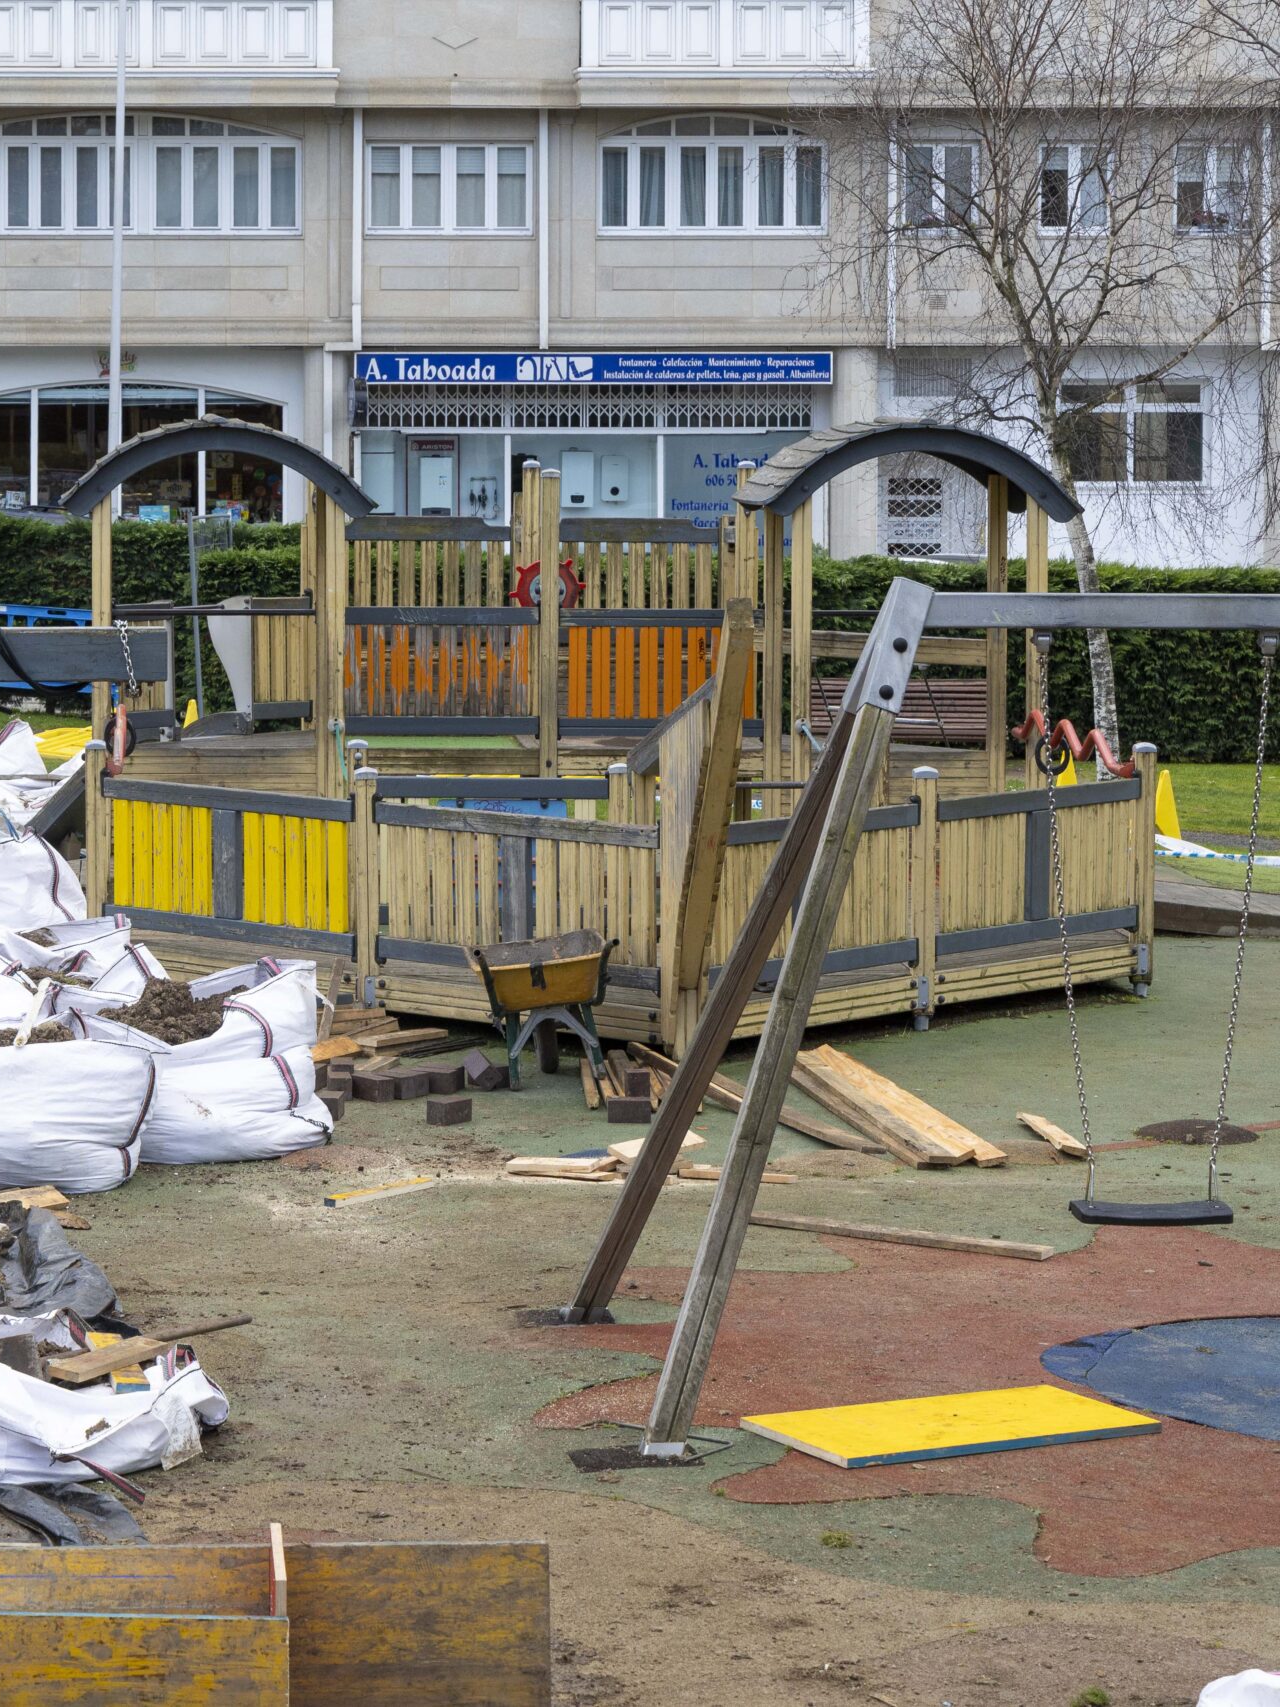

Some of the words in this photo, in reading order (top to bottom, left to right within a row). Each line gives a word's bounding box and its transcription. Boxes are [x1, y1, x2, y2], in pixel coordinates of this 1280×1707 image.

[365, 357, 388, 380] A.
[394, 357, 496, 380] Taboada
[662, 357, 703, 367] Calefacción
[707, 357, 762, 367] Mantenimiento
[766, 357, 815, 368] Reparaciones
[603, 370, 644, 379] Instalación
[644, 370, 654, 379] de
[654, 370, 685, 379] calderas
[686, 370, 695, 379] de
[742, 372, 756, 381] gas
[762, 370, 785, 381] gasoil
[693, 453, 708, 469] A.
[705, 473, 725, 487] 606
